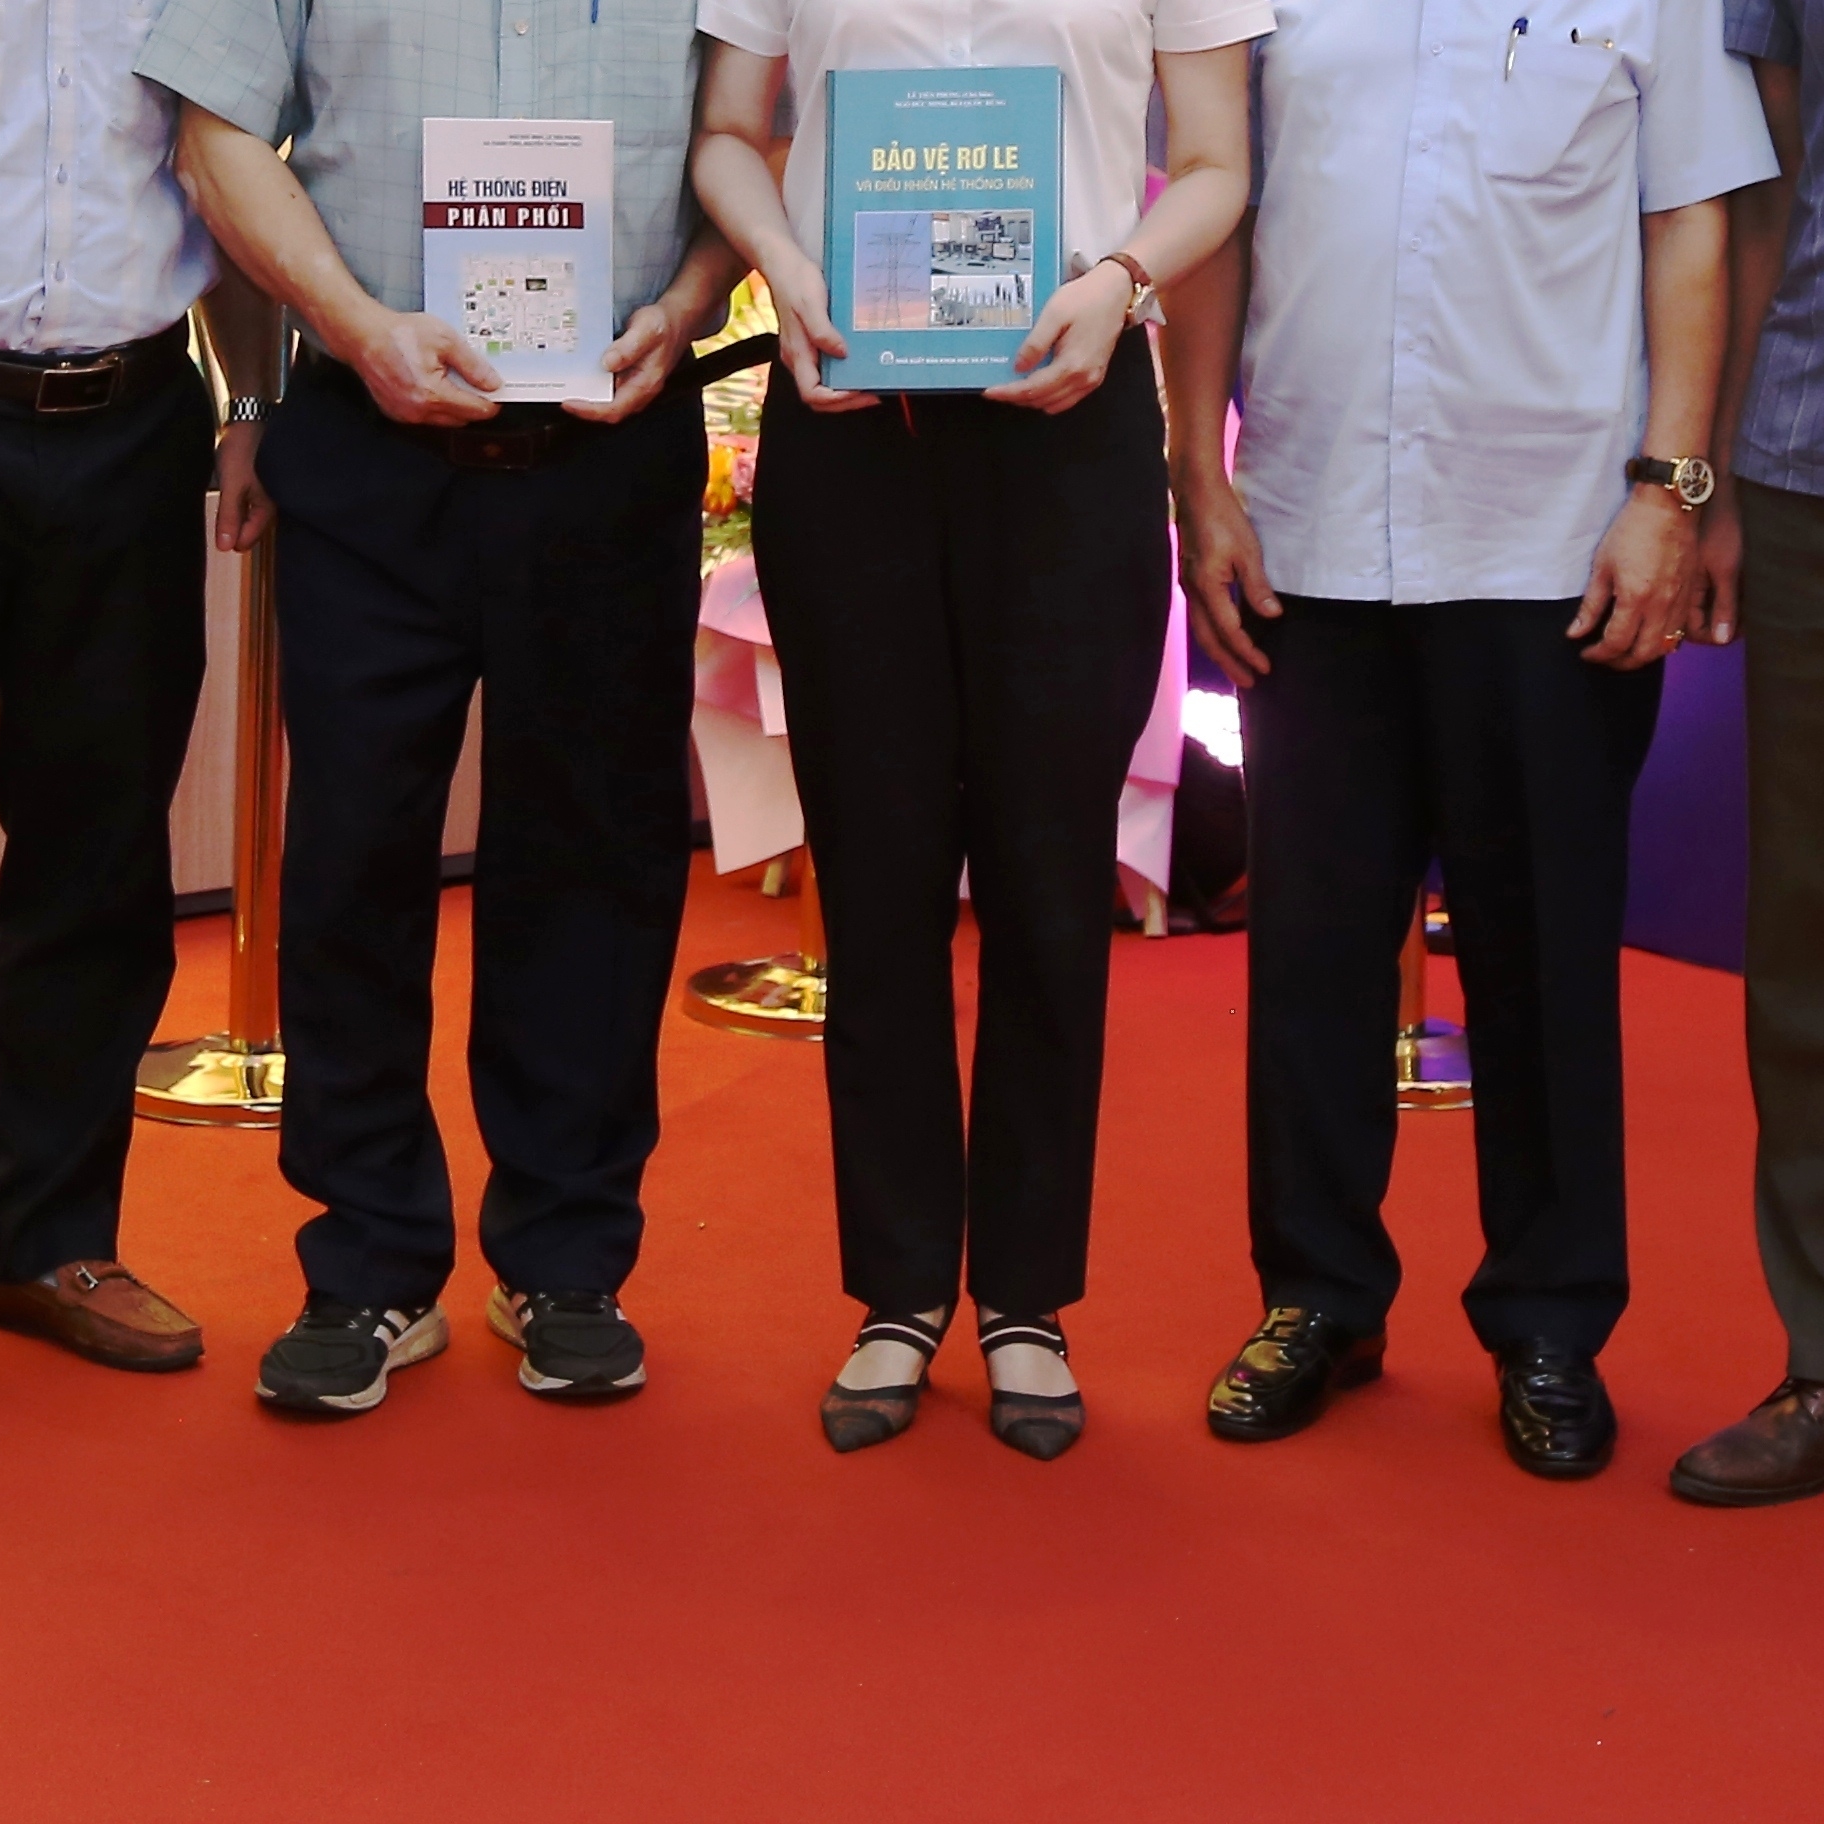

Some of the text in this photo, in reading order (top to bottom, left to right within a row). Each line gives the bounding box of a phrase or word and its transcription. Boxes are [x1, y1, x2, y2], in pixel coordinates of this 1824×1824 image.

[871, 140, 1019, 175] BẢO VỆ RƠ LE
[448, 175, 568, 202] HỆ THỐNG ĐIỆN
[447, 204, 570, 226] PHÂN PHỐI
